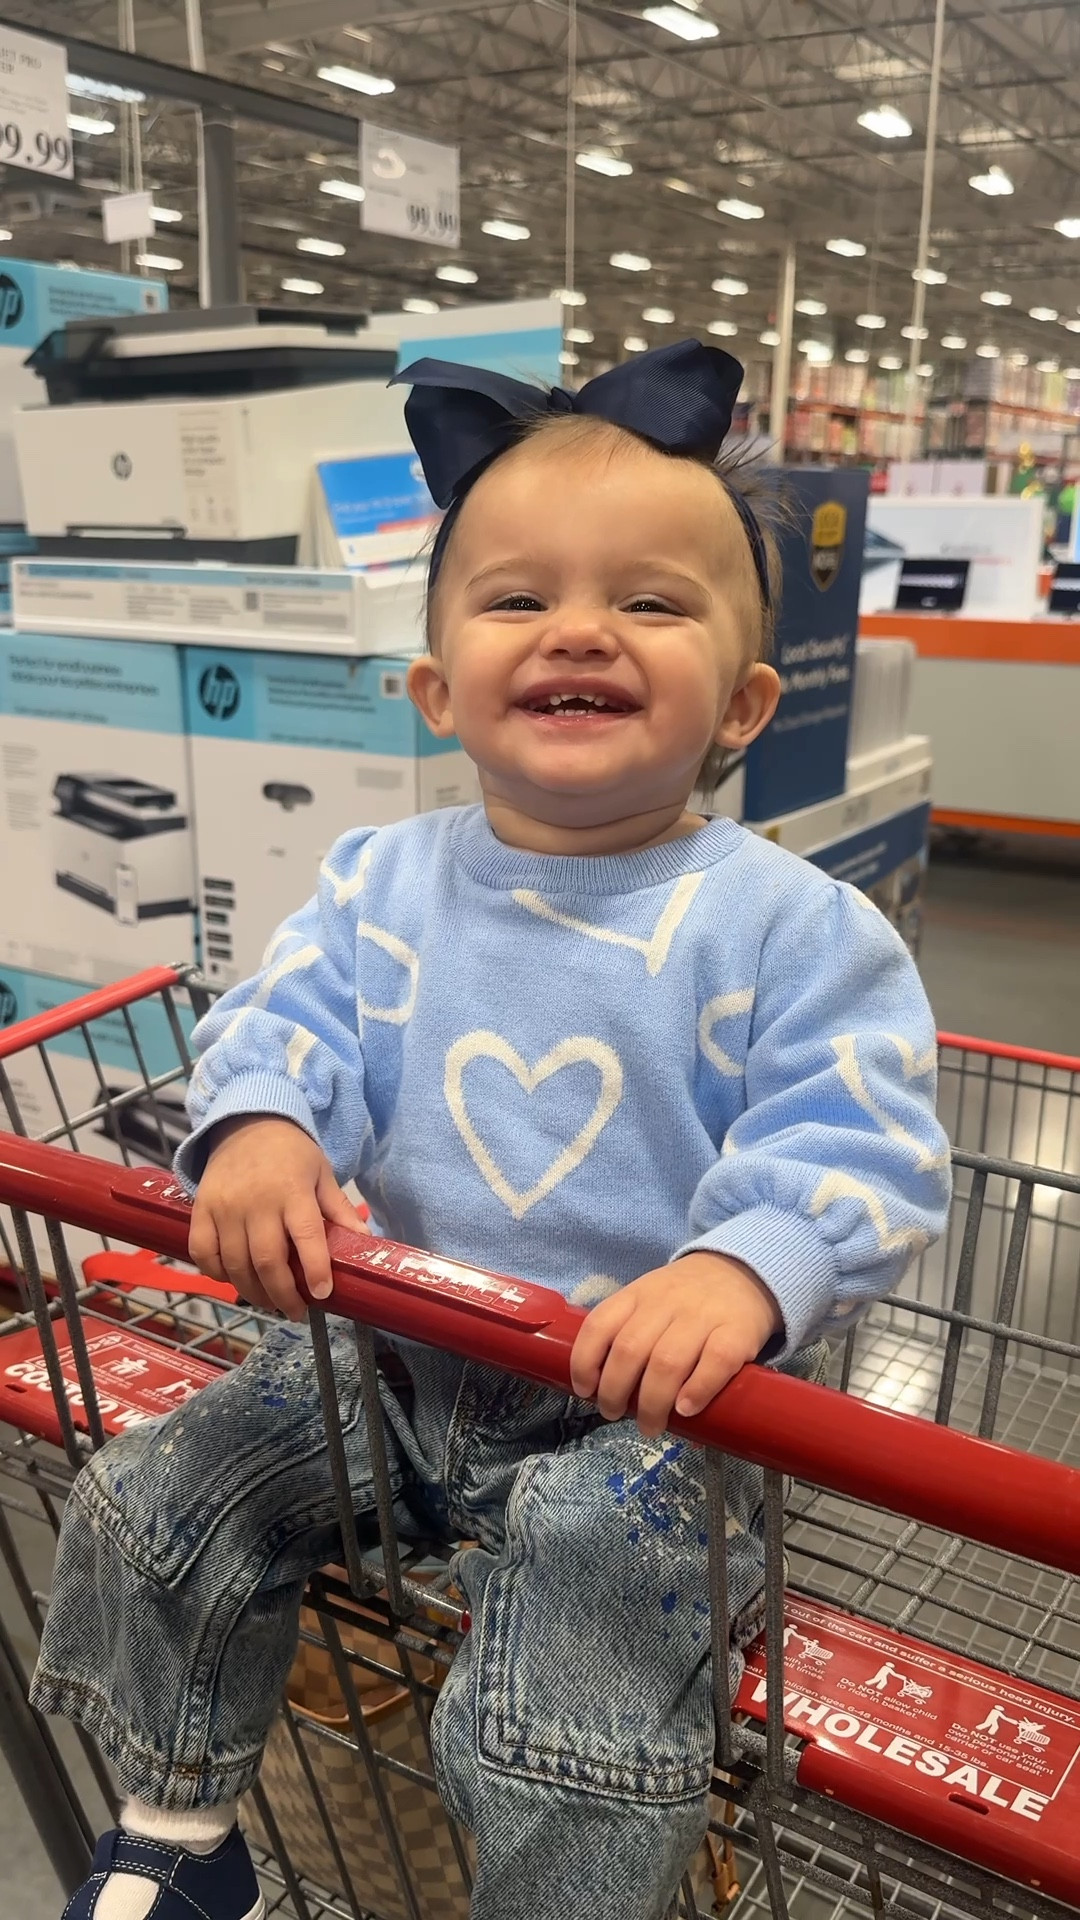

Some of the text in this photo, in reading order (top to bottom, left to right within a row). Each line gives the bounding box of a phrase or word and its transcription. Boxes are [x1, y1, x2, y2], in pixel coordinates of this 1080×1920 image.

[200, 665, 240, 720] hp
[791, 1607, 812, 1619] out
[812, 1615, 828, 1625] of
[827, 1621, 847, 1634] the
[848, 1630, 873, 1644] cart
[874, 1639, 899, 1653] and
[899, 1650, 936, 1671] suffer
[938, 1665, 947, 1673] a
[948, 1668, 997, 1691] serious
[999, 1688, 1032, 1705] head
[1034, 1701, 1076, 1723] injury.
[796, 1667, 825, 1681] times.
[803, 1663, 826, 1675] your
[836, 1682, 919, 1720] to ride in basket.
[840, 1677, 938, 1721] Do NOT allow child
[784, 1679, 819, 1697] hildren
[820, 1694, 846, 1709] ages
[847, 1706, 871, 1719] 6-48
[872, 1716, 912, 1736] months
[913, 1732, 936, 1746] and
[937, 1743, 968, 1761] 15-35
[969, 1755, 990, 1770] lbs.
[951, 1722, 1048, 1765] Do NOT use your
[751, 1679, 1050, 1822] WHOLESALE
[944, 1733, 1044, 1777] carrier or car seat.
[948, 1728, 1054, 1775] own personal infant
